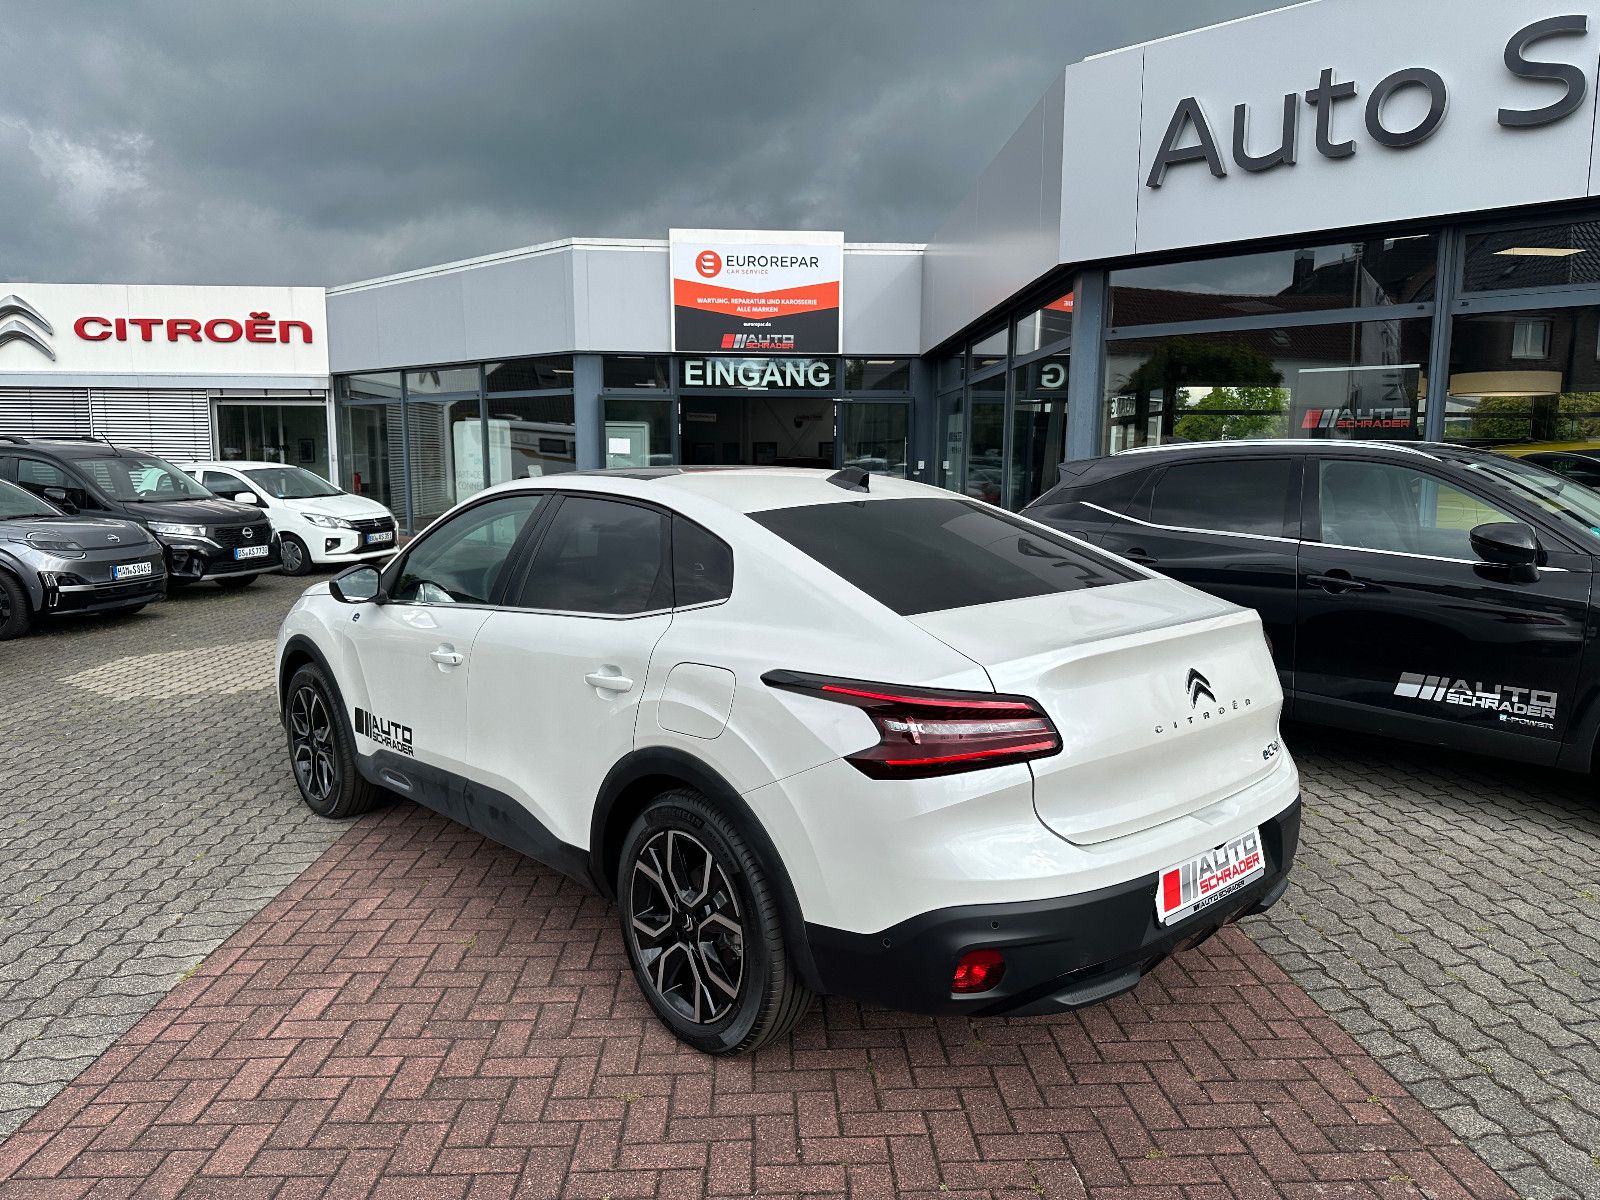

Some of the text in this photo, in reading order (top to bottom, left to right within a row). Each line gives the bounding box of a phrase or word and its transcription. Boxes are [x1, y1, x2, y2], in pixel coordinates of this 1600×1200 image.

[1146, 15, 1588, 188] Auto S
[726, 255, 819, 268] EUROREPAR
[697, 297, 730, 305] WARTUNG,
[746, 334, 795, 343] AUTO
[684, 360, 830, 387] EINGANG
[1336, 420, 1411, 428] SCHRADER
[1338, 407, 1411, 420] AUTO
[1446, 693, 1555, 719] SCHRADER
[1447, 679, 1558, 709] AUTO
[372, 715, 413, 745] AUTO
[372, 731, 414, 757] SCHRADER
[1198, 831, 1258, 880] AUTO
[1199, 852, 1260, 895] SCHRADER
[1199, 880, 1245, 911] AUTO SCHRADER
